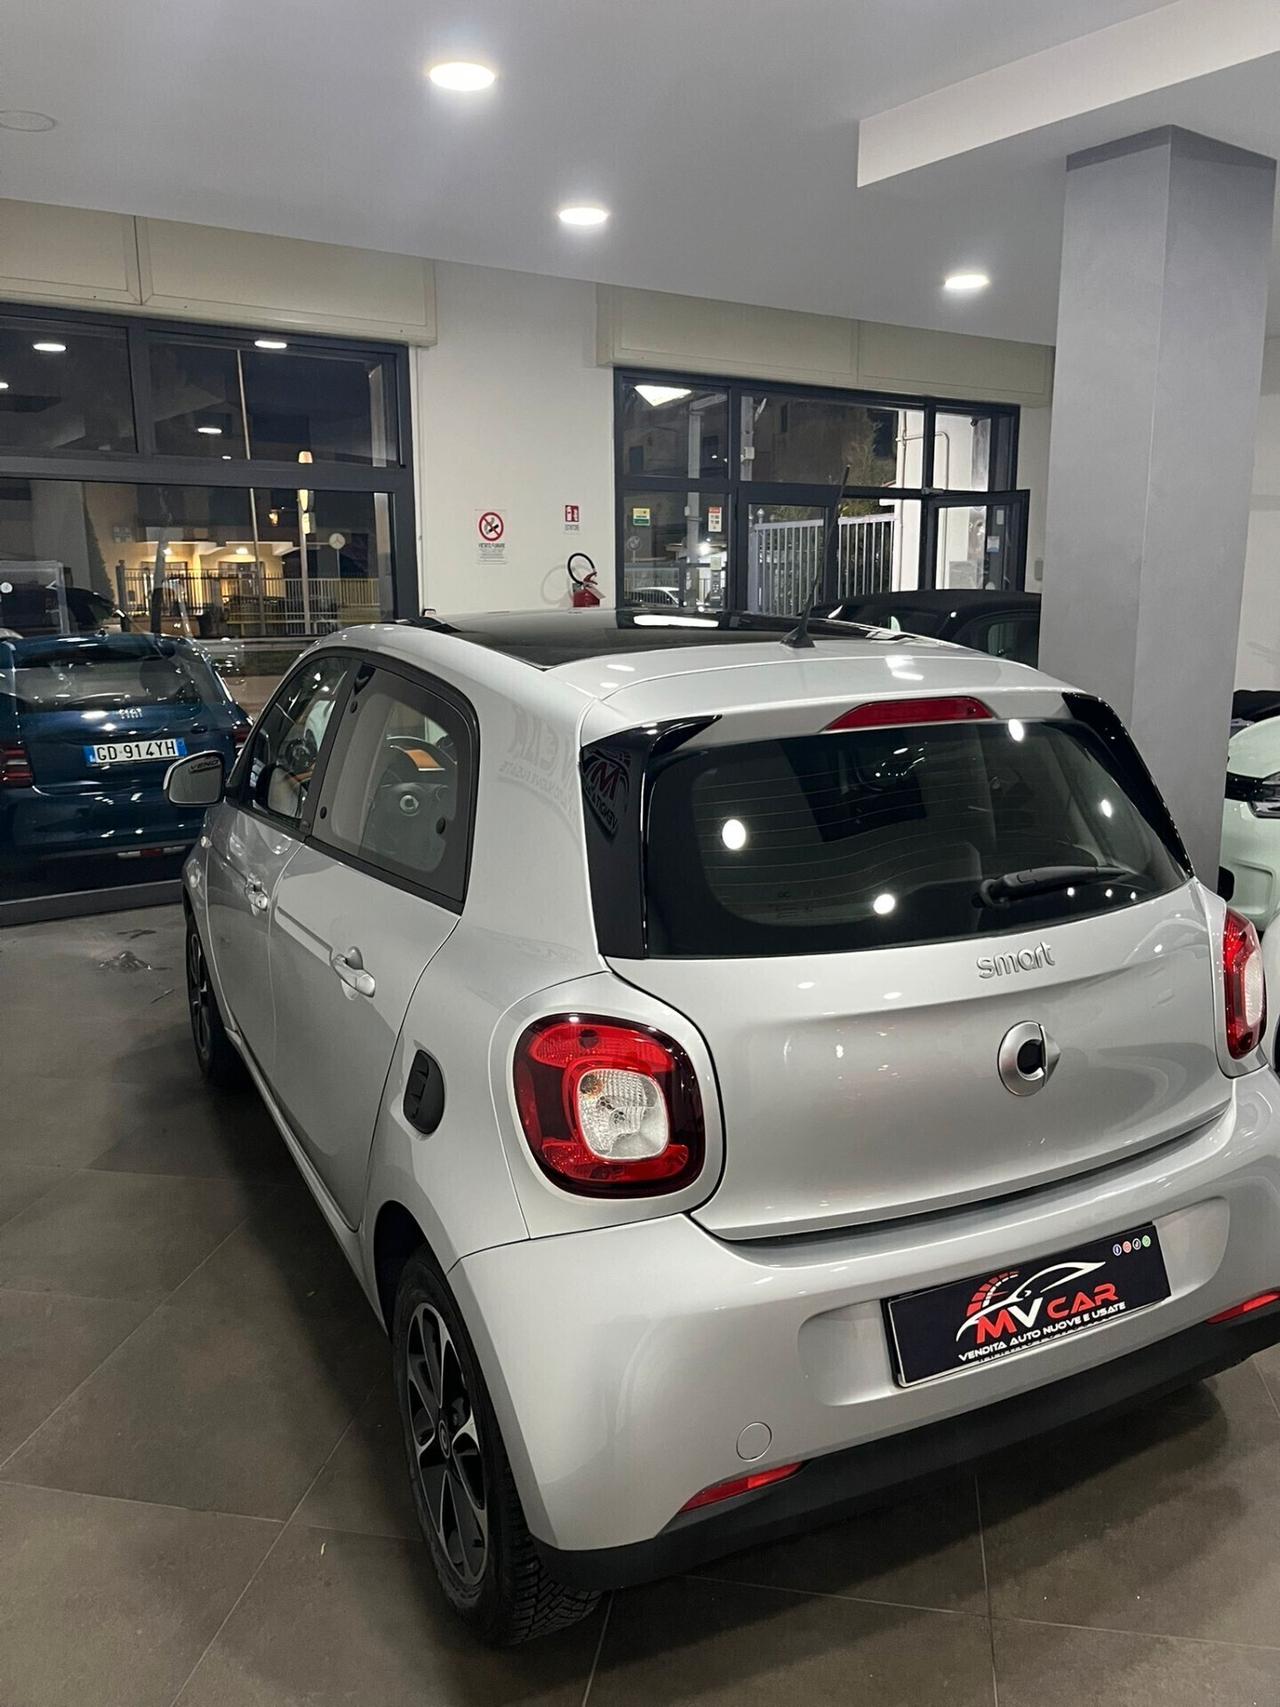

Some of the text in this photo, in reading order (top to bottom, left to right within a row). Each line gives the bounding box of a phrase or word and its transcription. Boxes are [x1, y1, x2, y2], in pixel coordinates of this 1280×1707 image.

[976, 942, 1056, 979] smart
[1047, 1283, 1118, 1318] CAR
[958, 1302, 1126, 1361] VENDITA AUTO NUOVE E USATE
